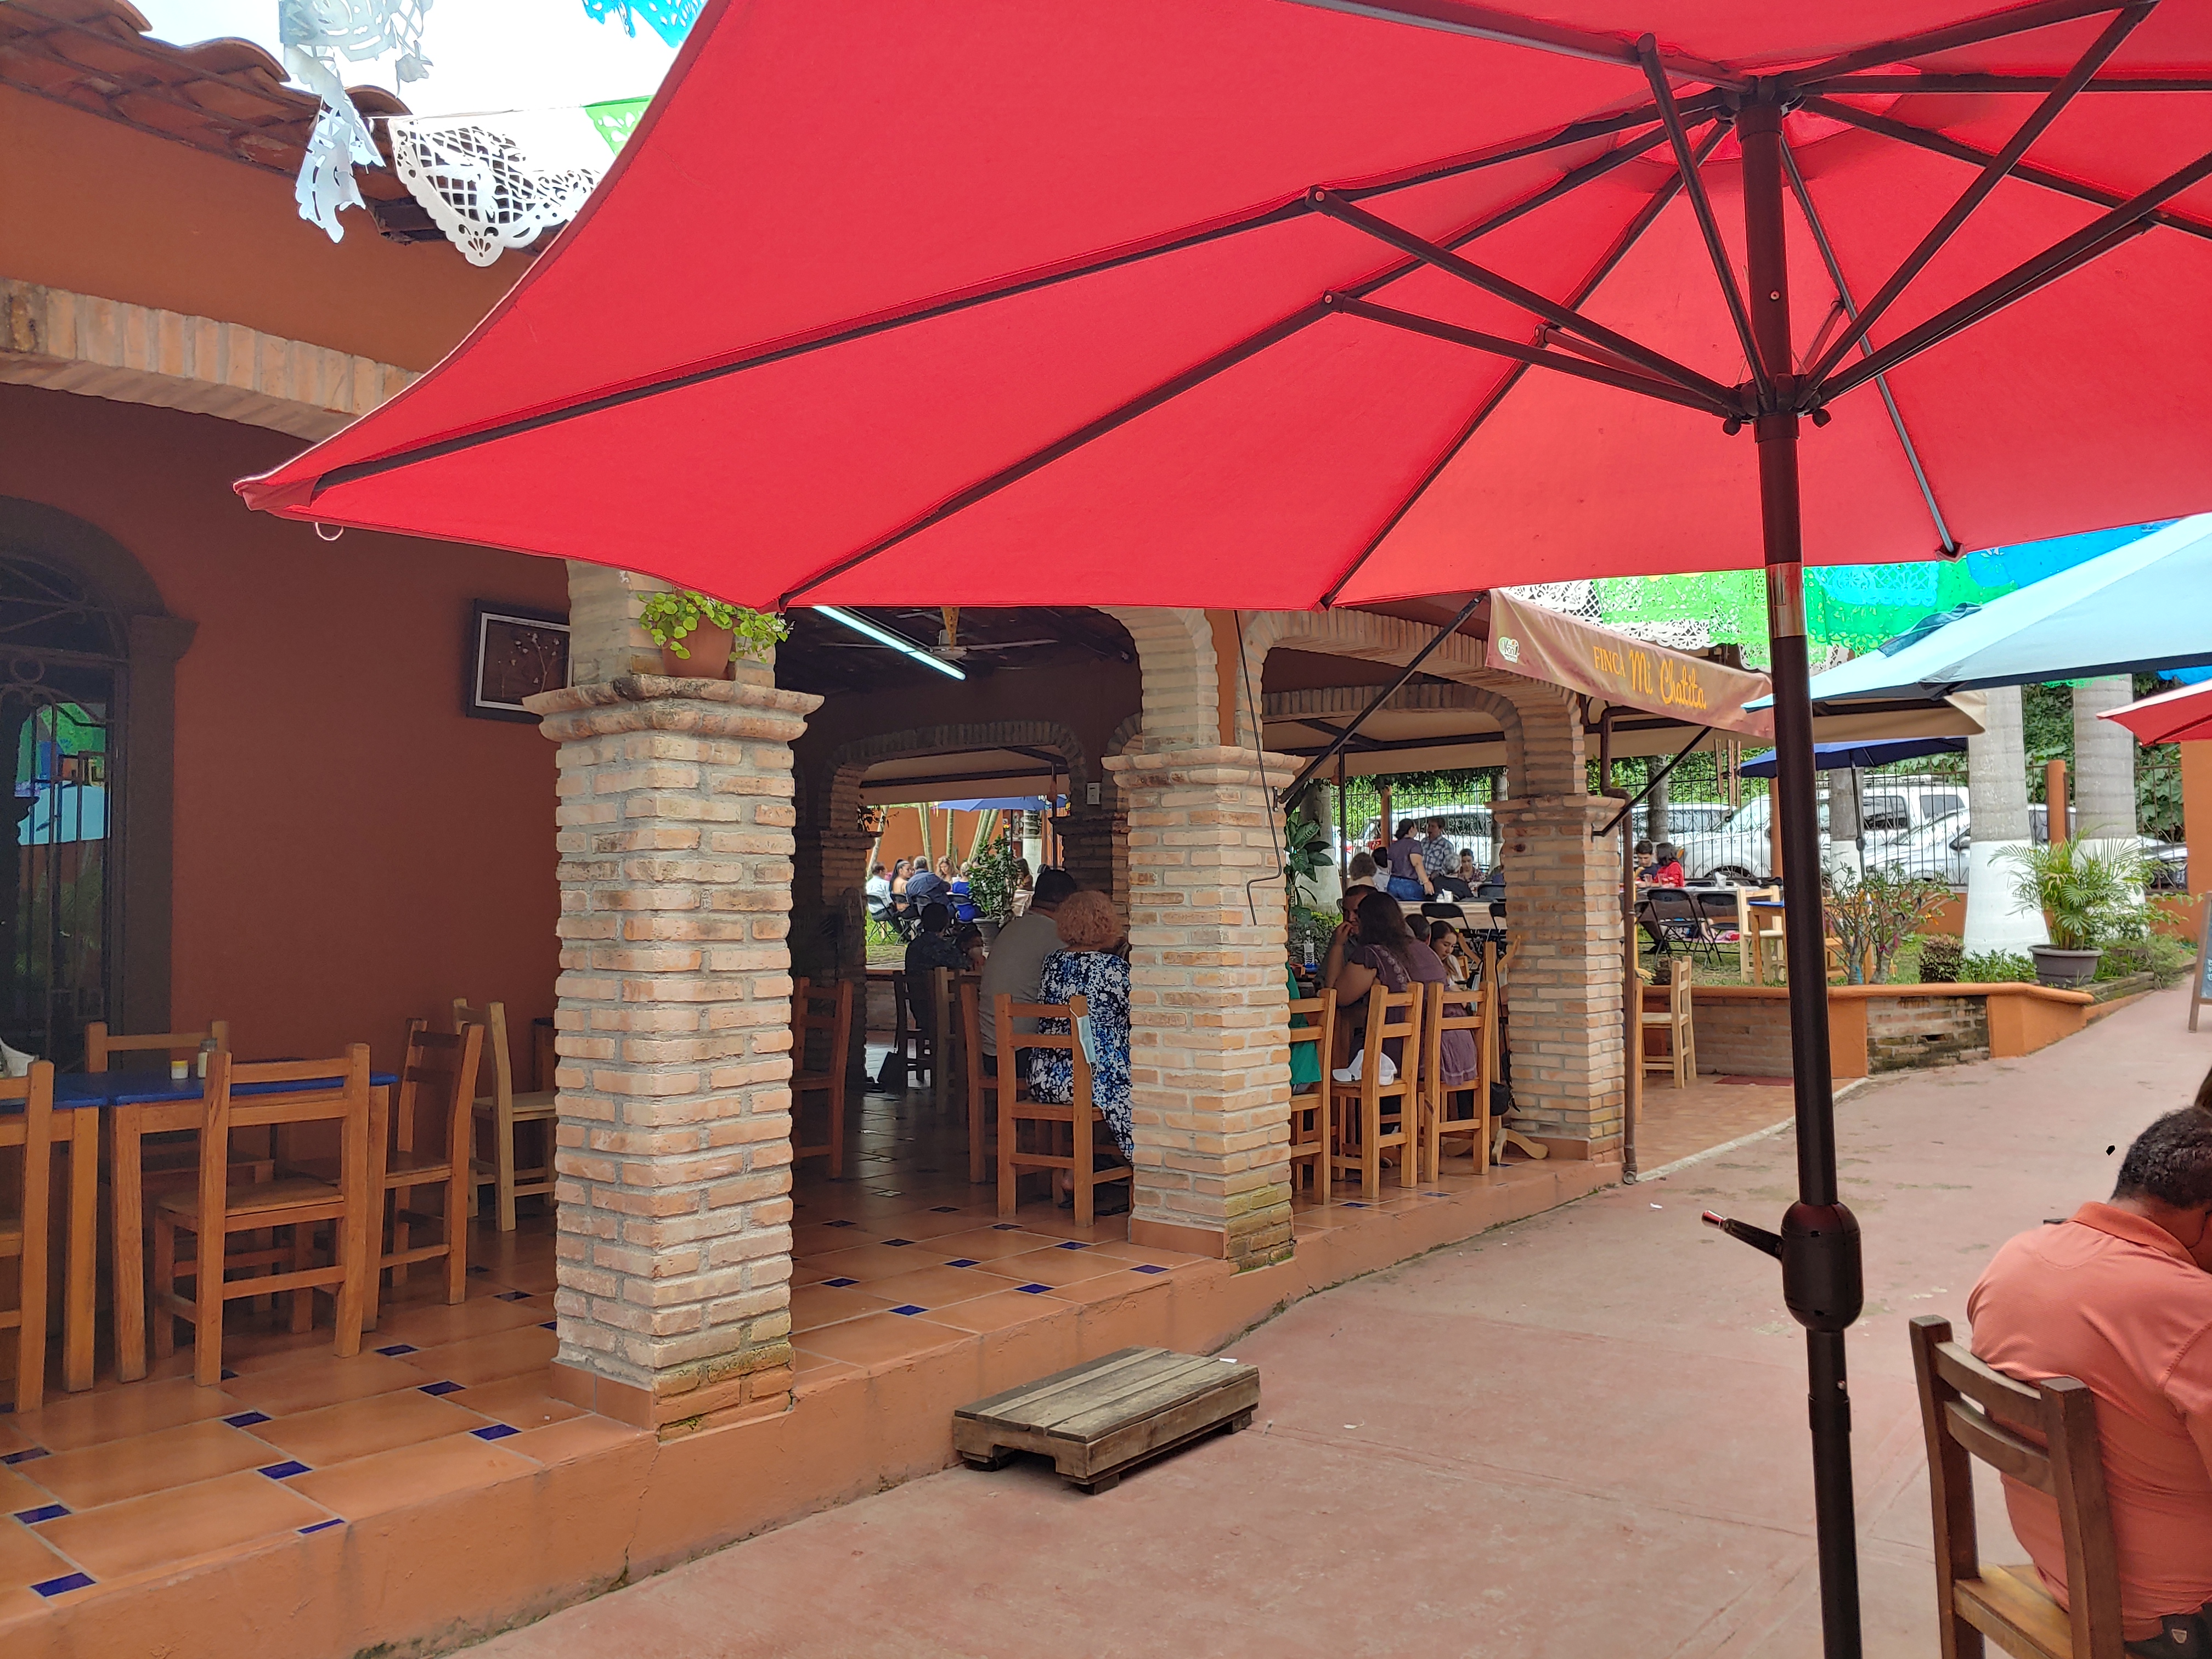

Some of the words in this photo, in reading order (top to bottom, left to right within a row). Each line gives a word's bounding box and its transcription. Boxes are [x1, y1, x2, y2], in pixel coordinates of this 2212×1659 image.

[1593, 646, 1626, 678] FINCA
[1629, 649, 1653, 695] Mi
[1660, 658, 1706, 709] Chatita
